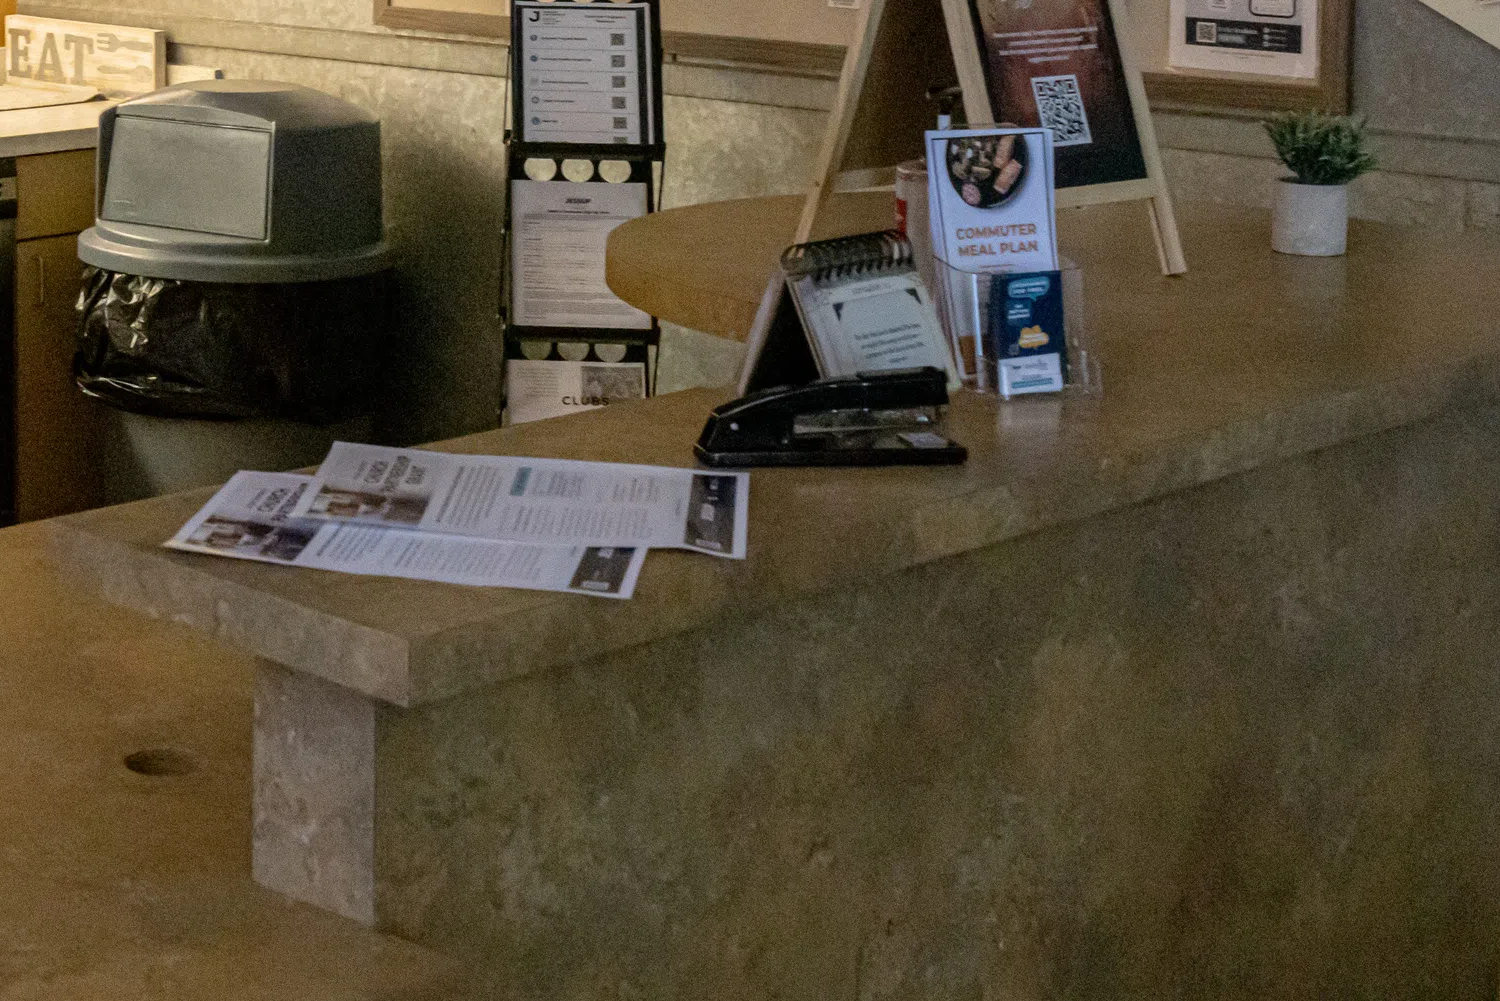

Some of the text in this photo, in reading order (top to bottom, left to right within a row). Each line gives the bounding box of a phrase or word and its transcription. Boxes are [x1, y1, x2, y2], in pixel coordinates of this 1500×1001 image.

[8, 28, 95, 87] EAT
[956, 223, 1038, 241] COMMUTER
[958, 240, 1039, 257] MEAL PLAN
[561, 396, 610, 407] CLUBS
